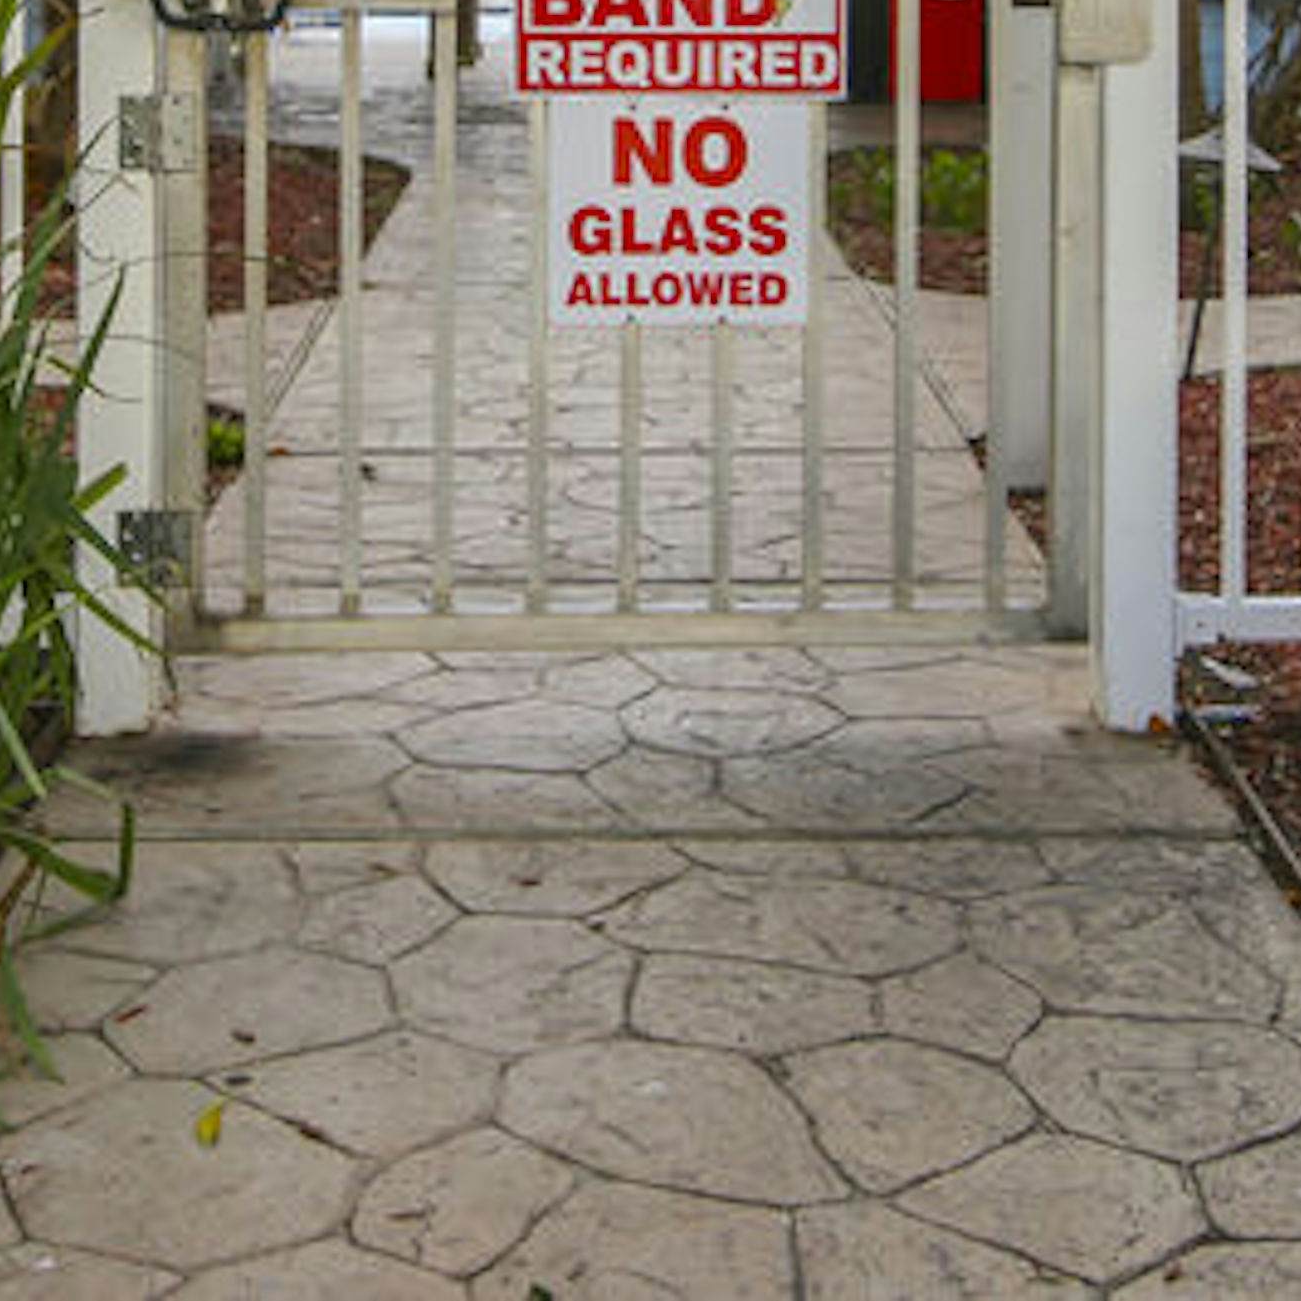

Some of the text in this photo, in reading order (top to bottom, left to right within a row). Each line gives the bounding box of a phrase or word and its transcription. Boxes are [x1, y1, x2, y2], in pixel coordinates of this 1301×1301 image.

[526, 41, 839, 88] REQUIRED
[612, 117, 749, 188] NO
[568, 206, 788, 256] GLASS
[566, 273, 788, 307] ALLOWED
